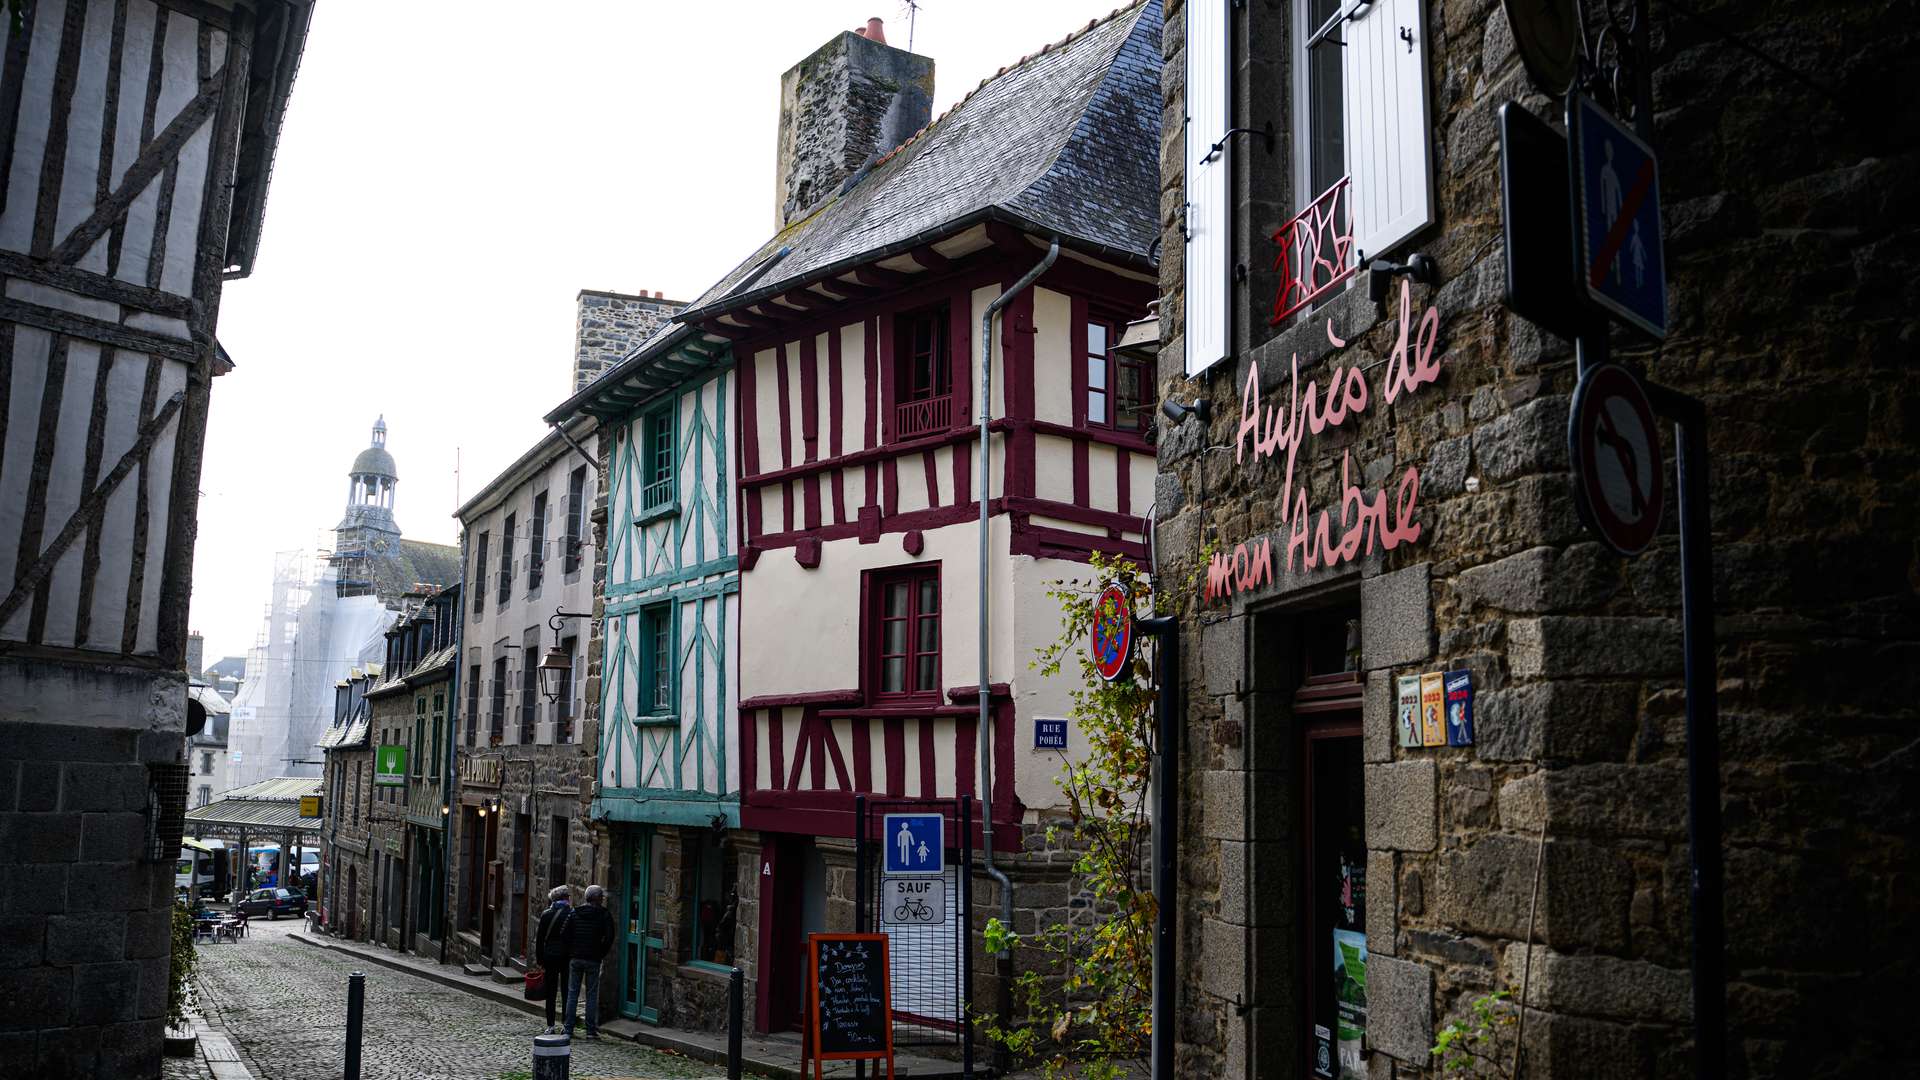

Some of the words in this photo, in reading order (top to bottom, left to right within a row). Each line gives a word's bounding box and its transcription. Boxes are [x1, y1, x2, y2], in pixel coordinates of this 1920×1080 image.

[1236, 318, 1369, 523] Auprès
[1384, 279, 1441, 405] de
[1204, 537, 1273, 607] mon
[1287, 449, 1421, 573] Arbre
[1042, 723, 1060, 732] RUE
[463, 758, 470, 780] LA
[472, 759, 496, 783] PROUE
[762, 862, 771, 875] A
[897, 882, 932, 893] SAUF
